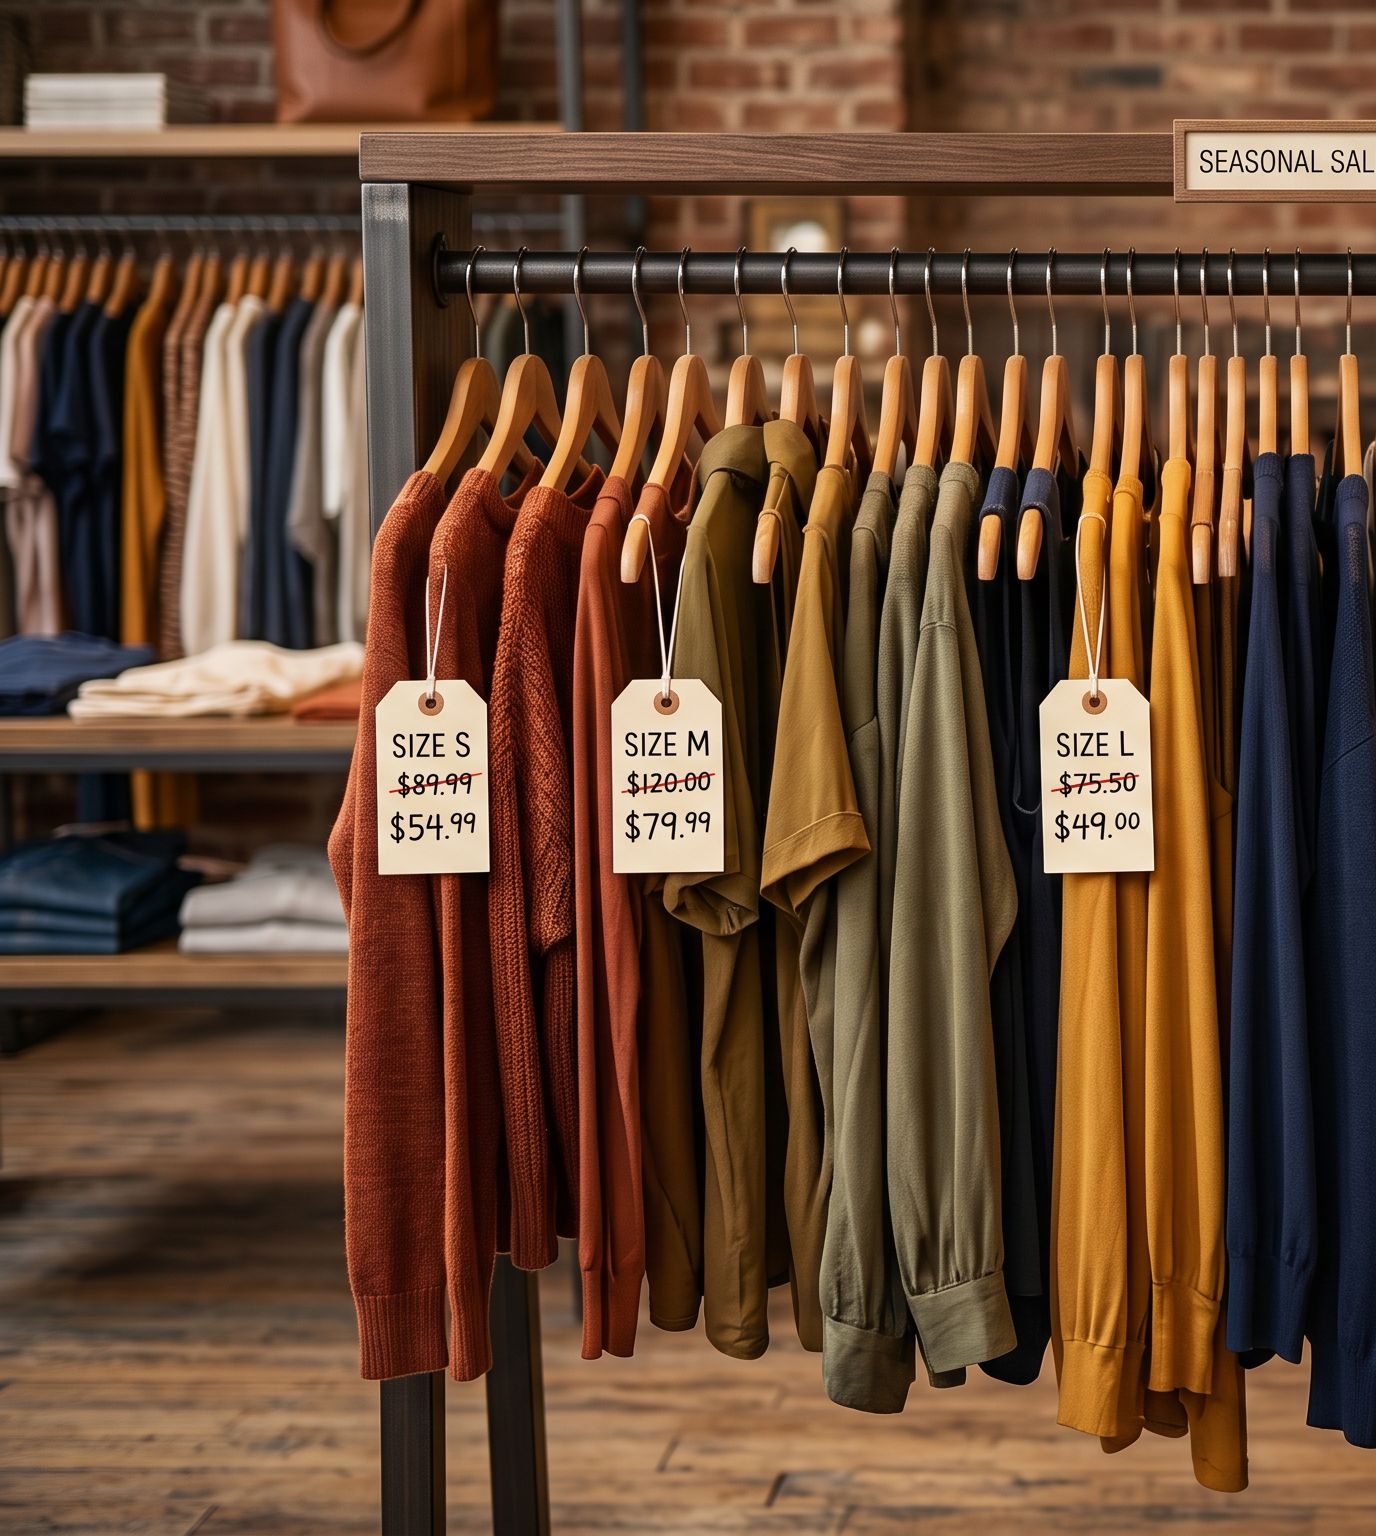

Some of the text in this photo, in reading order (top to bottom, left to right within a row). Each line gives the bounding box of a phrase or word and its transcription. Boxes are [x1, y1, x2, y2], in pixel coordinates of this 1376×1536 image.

[1199, 149, 1324, 174] SEASONAL
[392, 731, 471, 759] SIZE S
[624, 730, 710, 757] SIZE M
[1056, 730, 1135, 758] SIZE L
[397, 771, 473, 799] $89.99
[627, 770, 711, 798] $120.00
[1059, 770, 1137, 798] $75.50
[390, 811, 476, 844] $54.99
[625, 809, 711, 843] $79.99
[1054, 809, 1141, 843] $49.00
